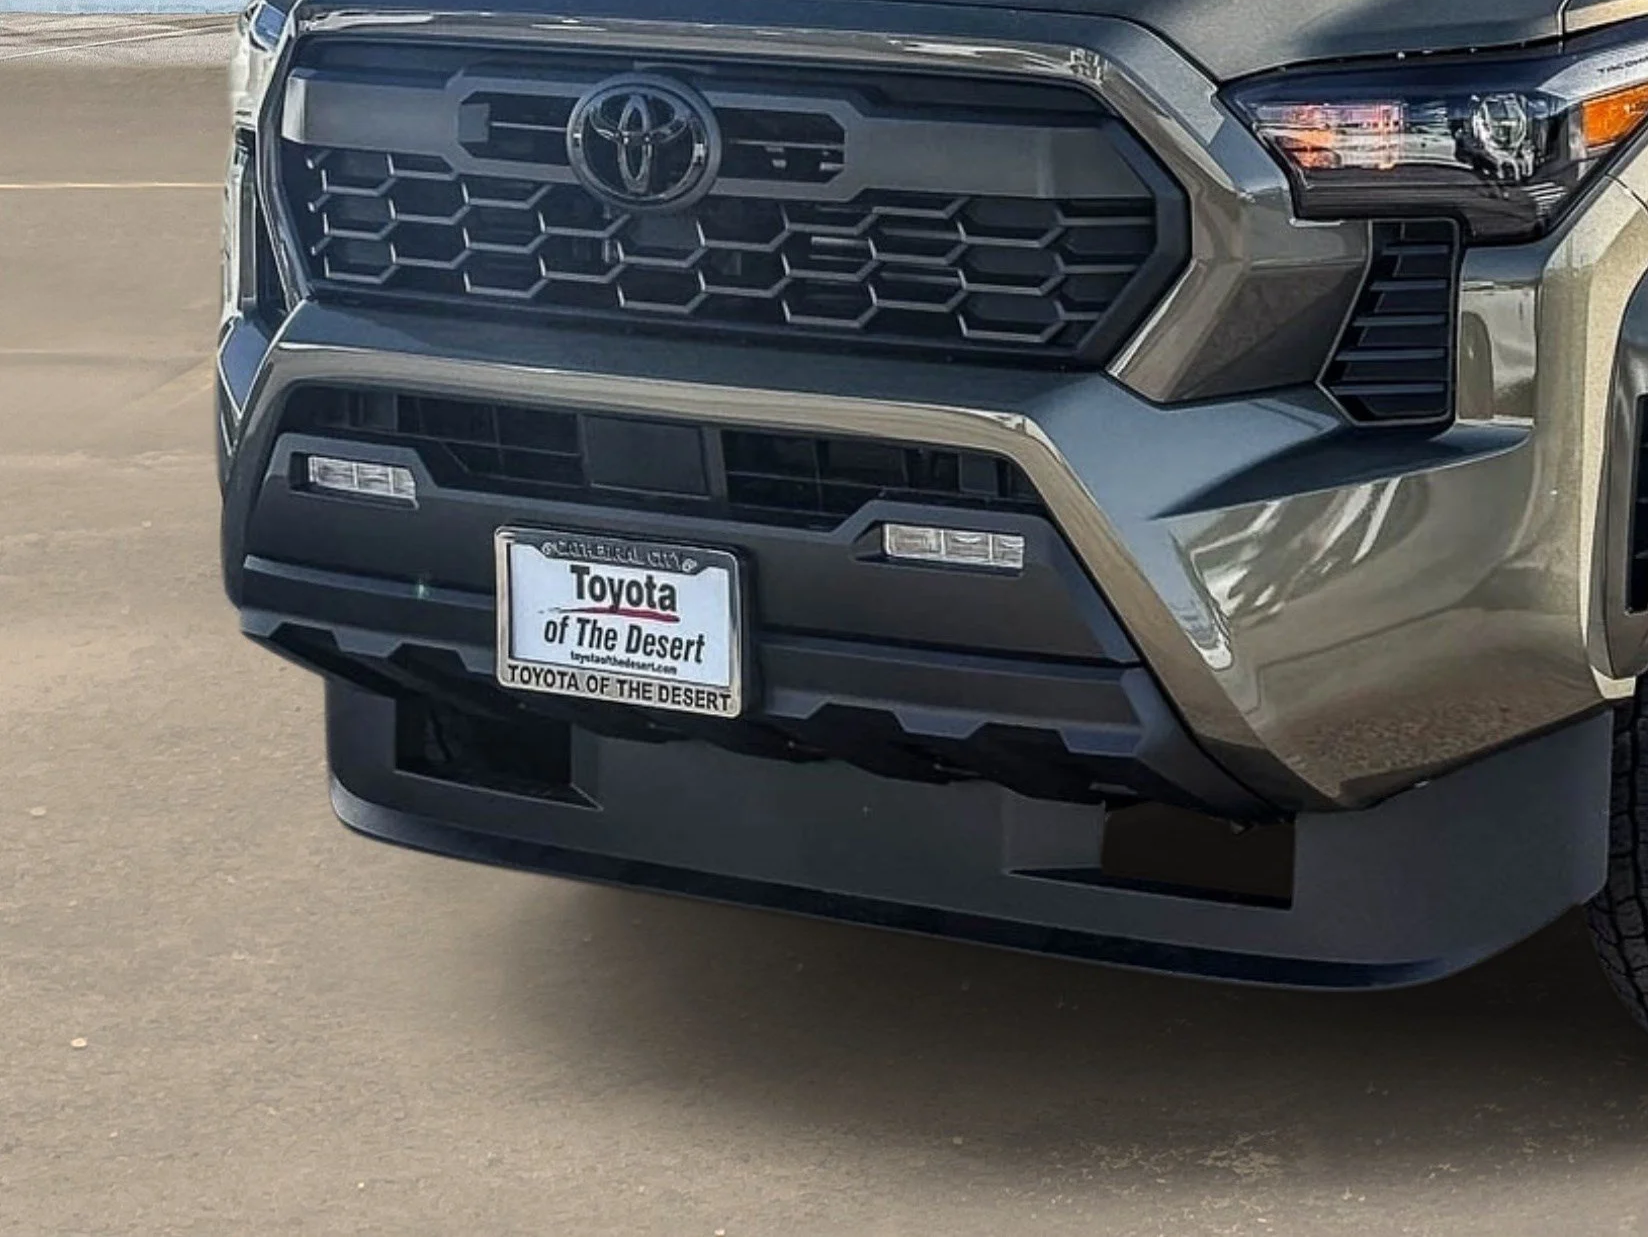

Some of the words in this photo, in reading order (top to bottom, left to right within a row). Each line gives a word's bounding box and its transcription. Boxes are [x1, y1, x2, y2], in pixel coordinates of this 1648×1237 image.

[570, 564, 679, 612] Toyota
[544, 615, 571, 645] of
[576, 617, 618, 654] The
[625, 624, 706, 664] Desert
[570, 650, 678, 676] toyotaofthedesert.com
[507, 664, 580, 692] TOYOTA
[586, 675, 611, 695] OF
[616, 679, 653, 702] THE
[657, 685, 732, 712] DESERT
